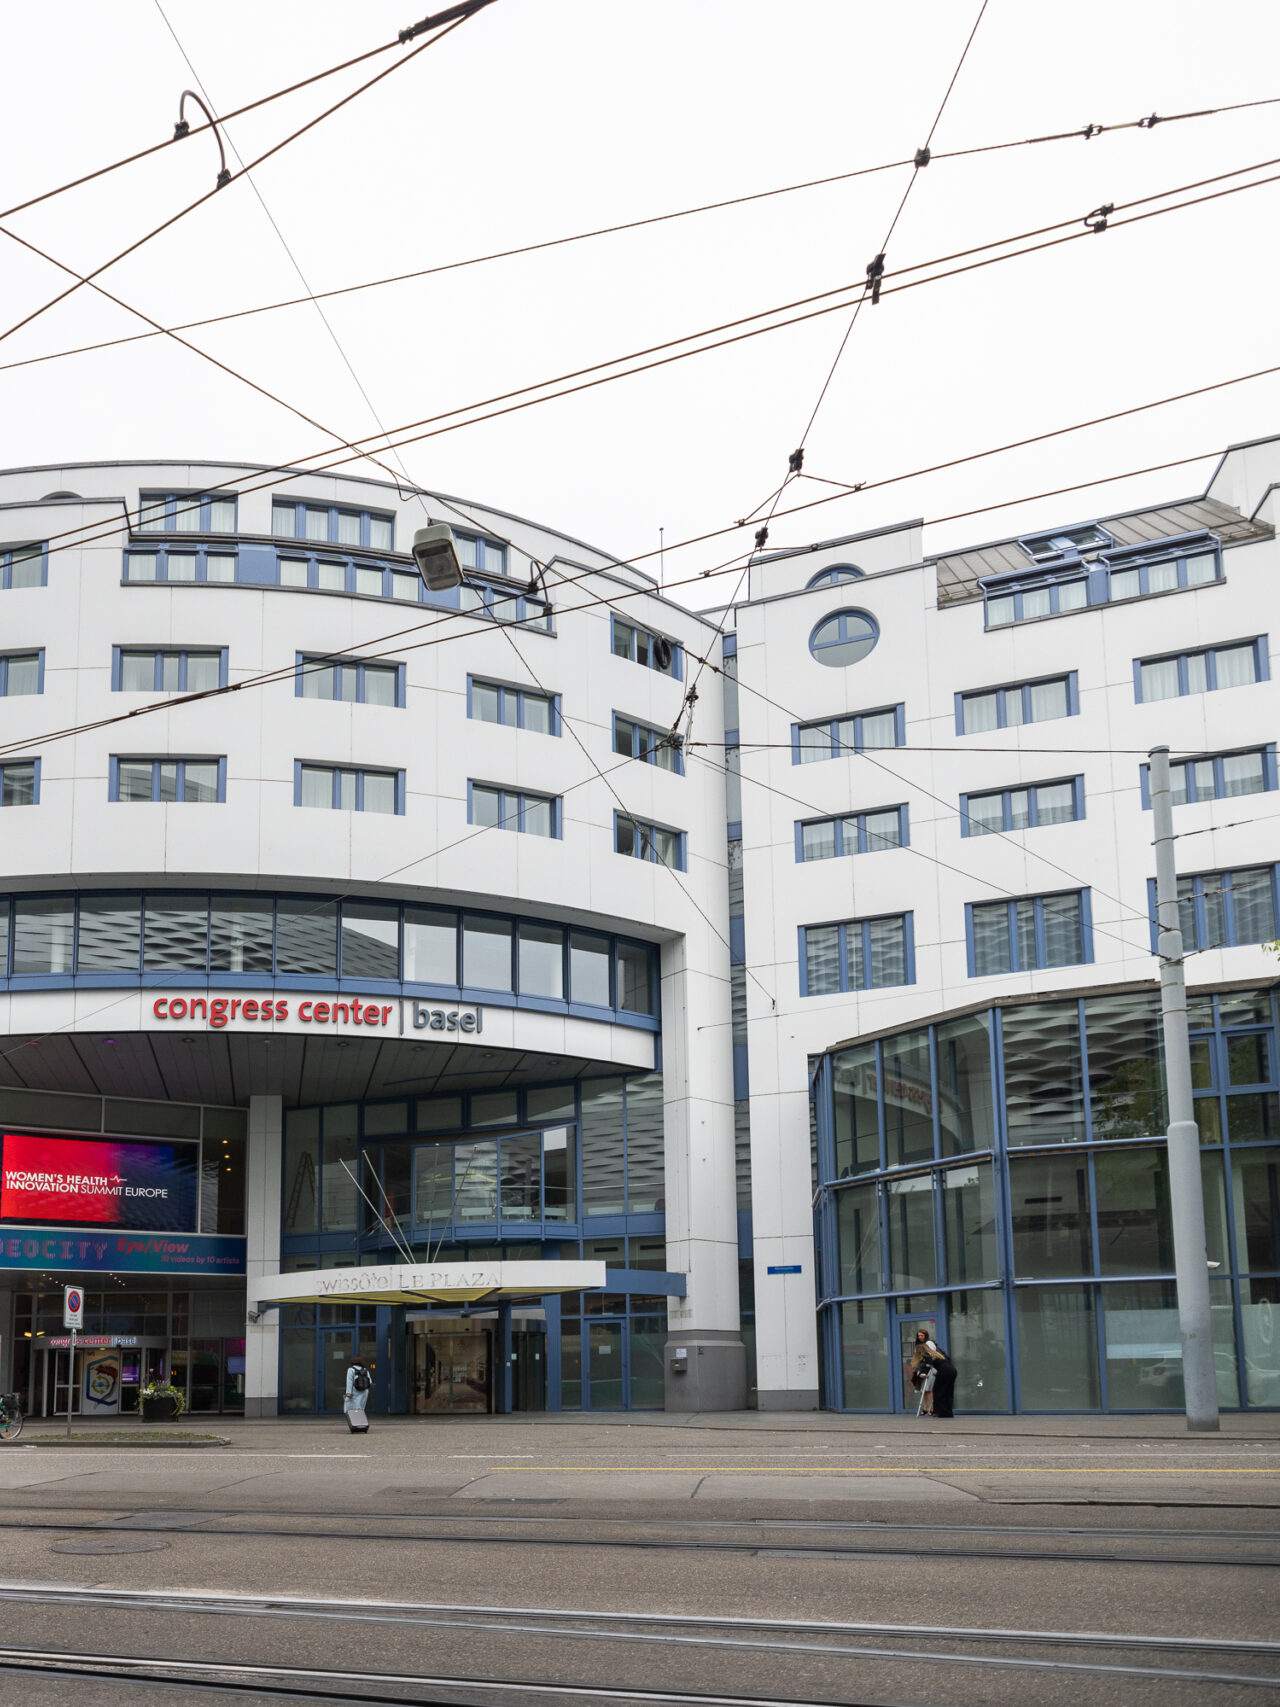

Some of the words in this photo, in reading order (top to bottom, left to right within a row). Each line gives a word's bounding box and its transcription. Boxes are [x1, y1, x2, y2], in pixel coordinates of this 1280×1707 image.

[153, 997, 289, 1027] congress
[298, 998, 393, 1026] center
[412, 1001, 483, 1033] basel
[5, 1171, 63, 1184] WOMEN'S
[66, 1175, 108, 1187] HEALTH
[6, 1180, 79, 1193] INNOVATION
[80, 1184, 123, 1196] SUMMIT
[125, 1187, 168, 1199] EUROPE
[116, 1238, 190, 1255] Eye/View
[170, 1255, 195, 1264] videos
[216, 1256, 240, 1265] artists
[399, 1273, 424, 1289] LE
[430, 1272, 501, 1288] PLAZA
